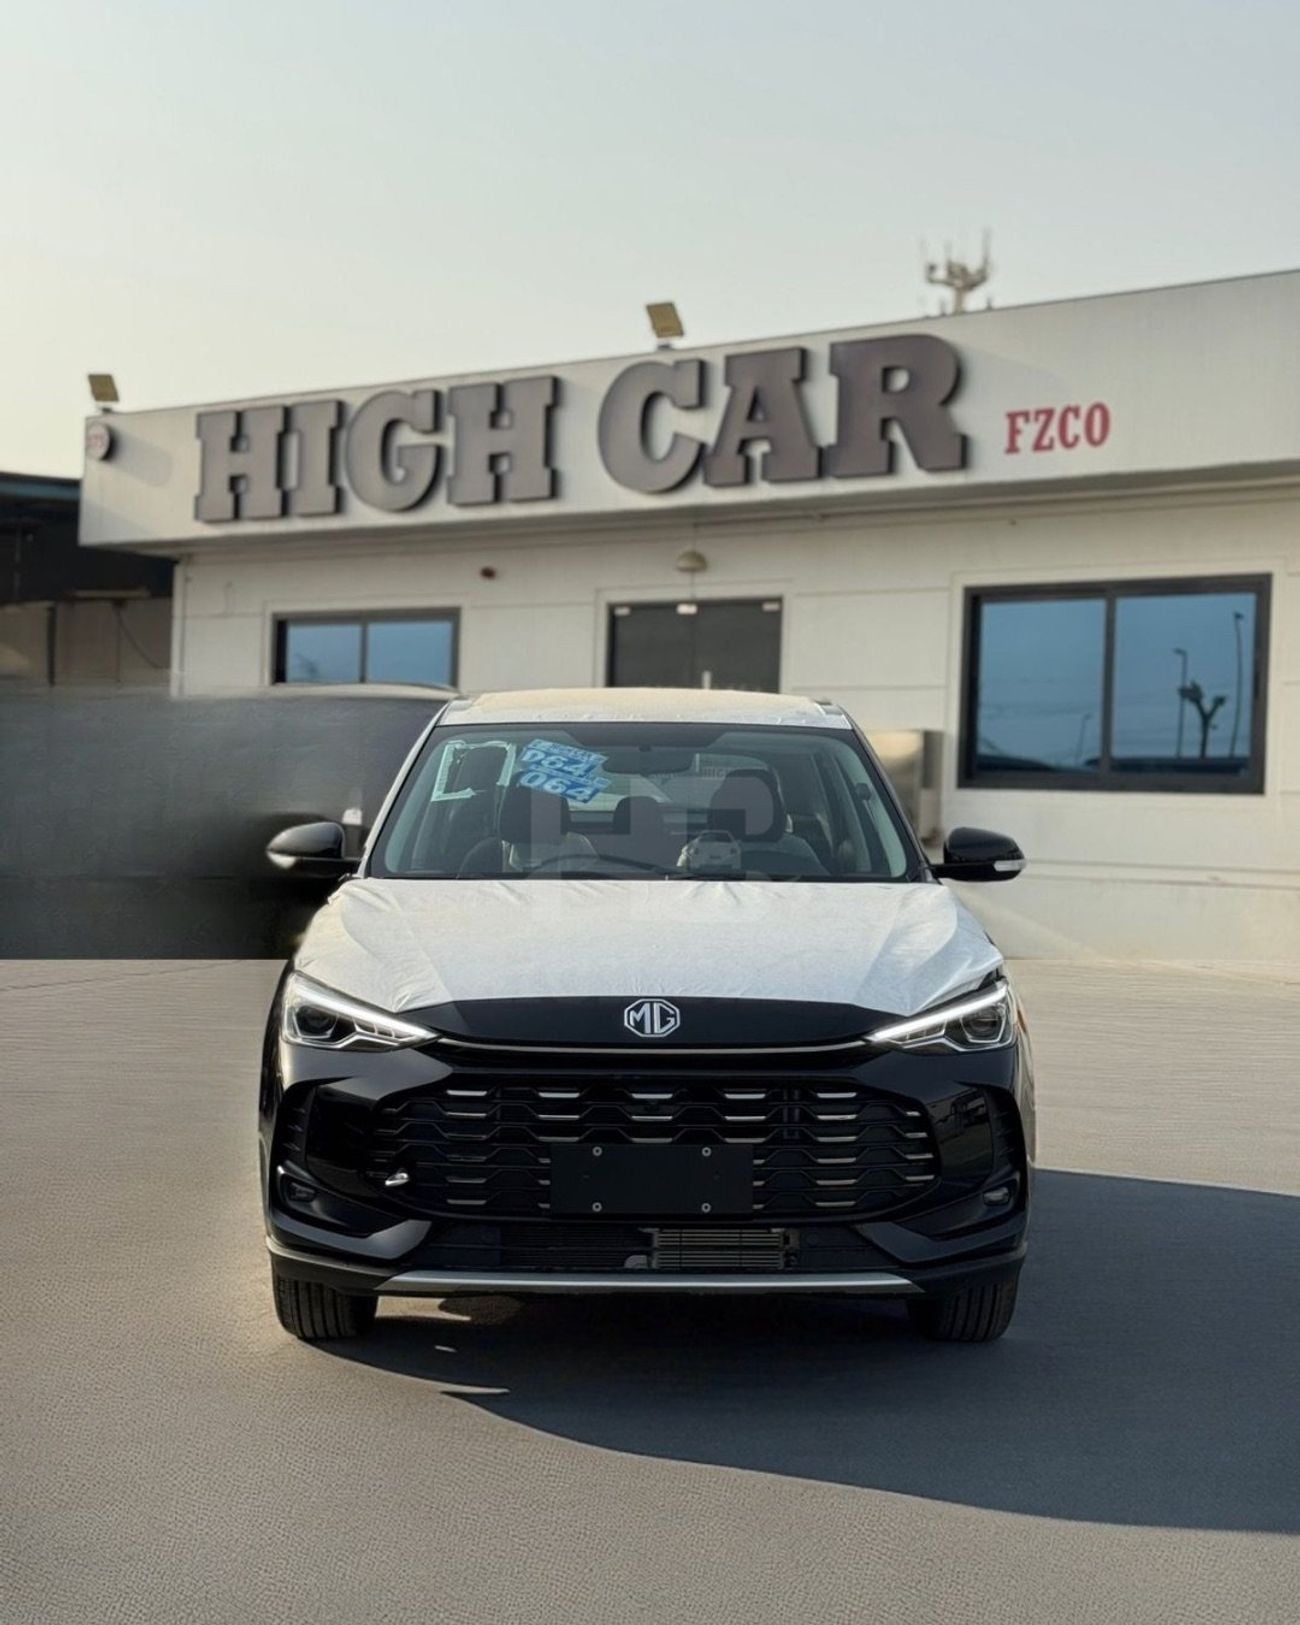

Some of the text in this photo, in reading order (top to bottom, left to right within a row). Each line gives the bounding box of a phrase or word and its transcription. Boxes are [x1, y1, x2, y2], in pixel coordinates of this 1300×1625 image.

[195, 333, 1111, 523] HIGH CAR FZCO
[624, 998, 680, 1037] MG
